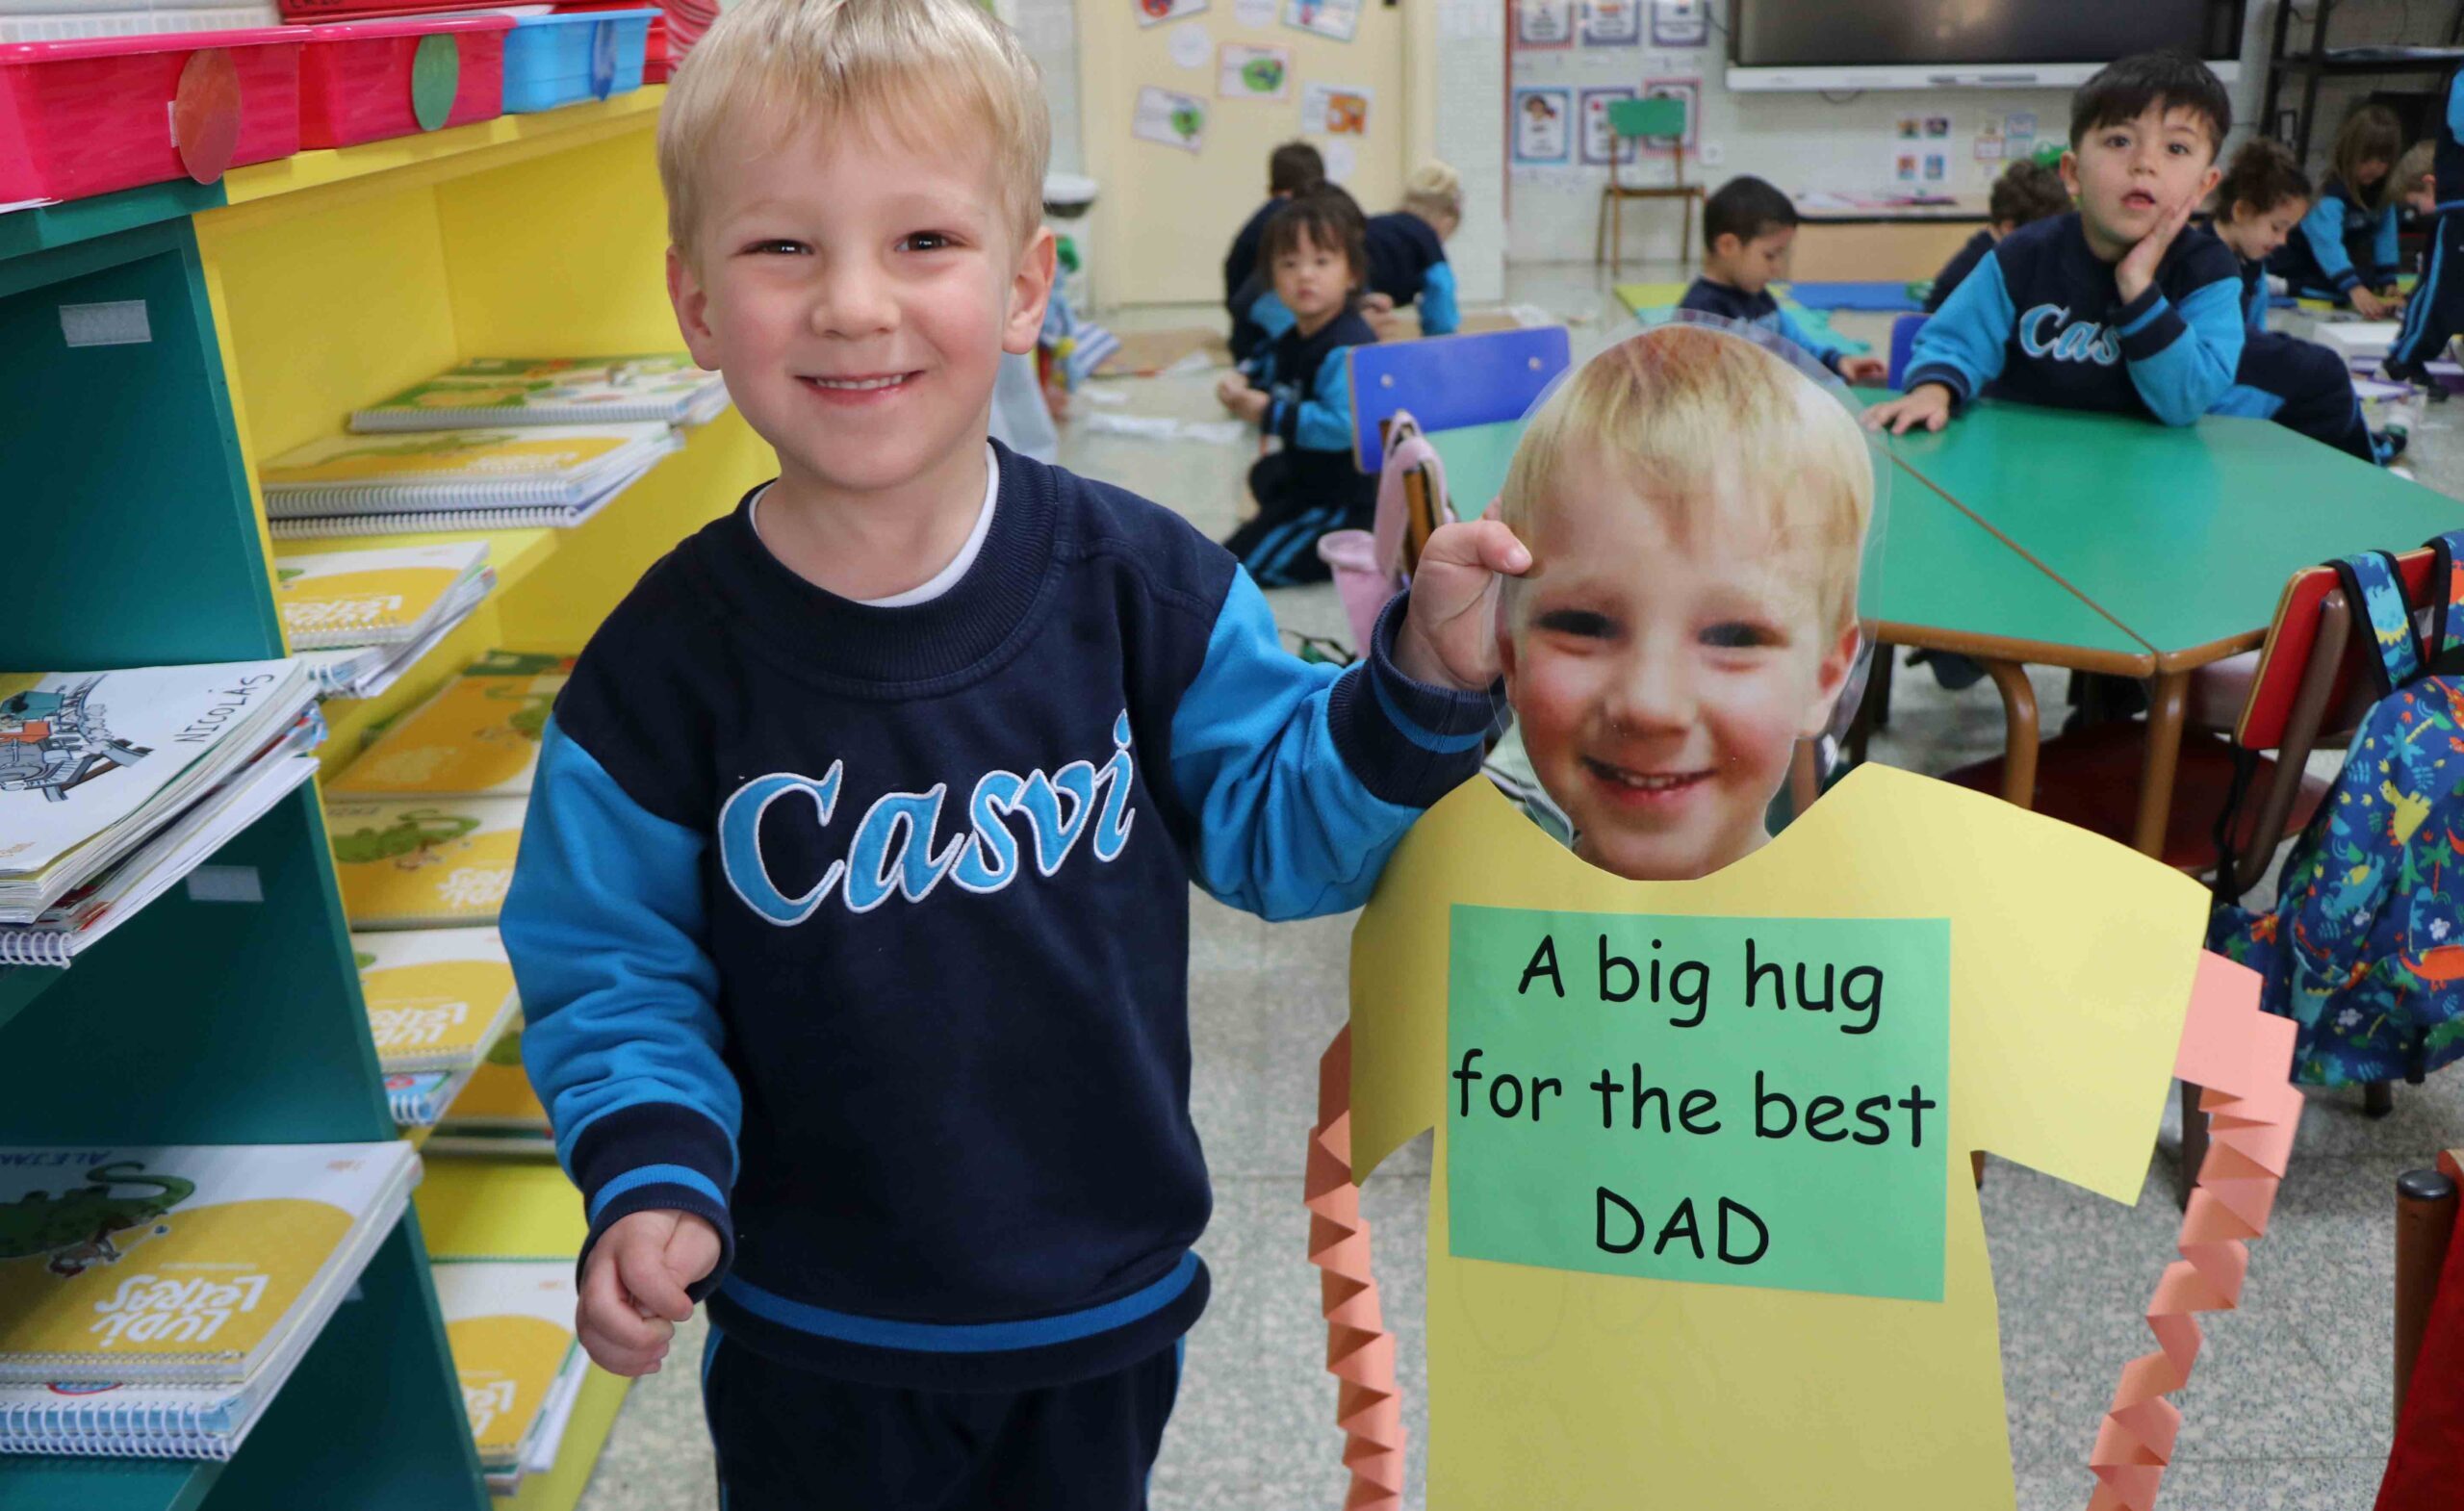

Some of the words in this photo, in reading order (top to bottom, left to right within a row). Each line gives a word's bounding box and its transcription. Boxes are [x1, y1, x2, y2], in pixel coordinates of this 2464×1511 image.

[2019, 303, 2121, 366] Cas
[718, 708, 1136, 927] Casvi
[1518, 934, 1565, 998] A
[1598, 934, 1710, 1028] big
[1744, 937, 1885, 1035] hug
[1451, 1048, 1562, 1122] for
[1590, 1062, 1721, 1135] the
[1754, 1069, 1938, 1148] best
[1596, 1186, 1770, 1266] DAD
